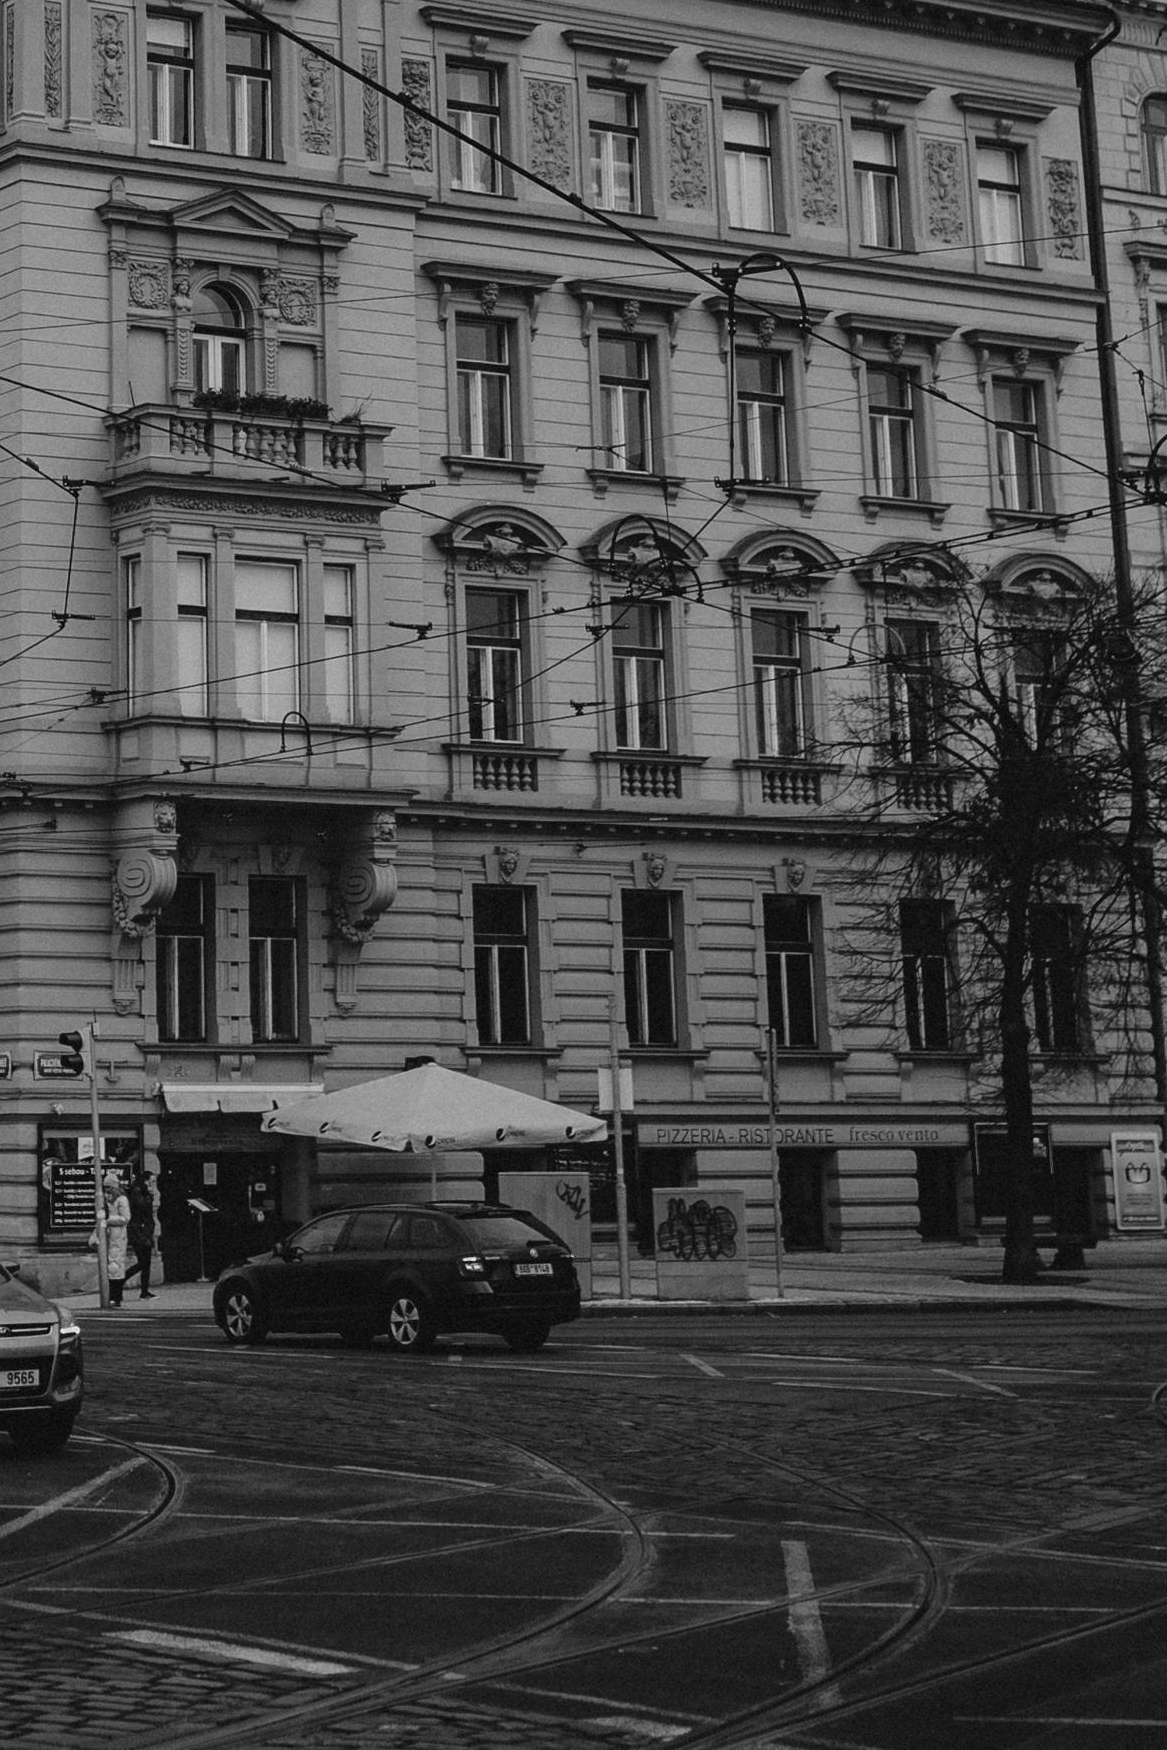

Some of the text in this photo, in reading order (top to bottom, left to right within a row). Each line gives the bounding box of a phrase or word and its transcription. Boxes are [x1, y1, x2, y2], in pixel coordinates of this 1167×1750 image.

[657, 1128, 726, 1144] PIZZERIA
[739, 1128, 834, 1144] RISTORANTE
[850, 1127, 939, 1142] fresco vento
[7, 1371, 35, 1385] 9565
